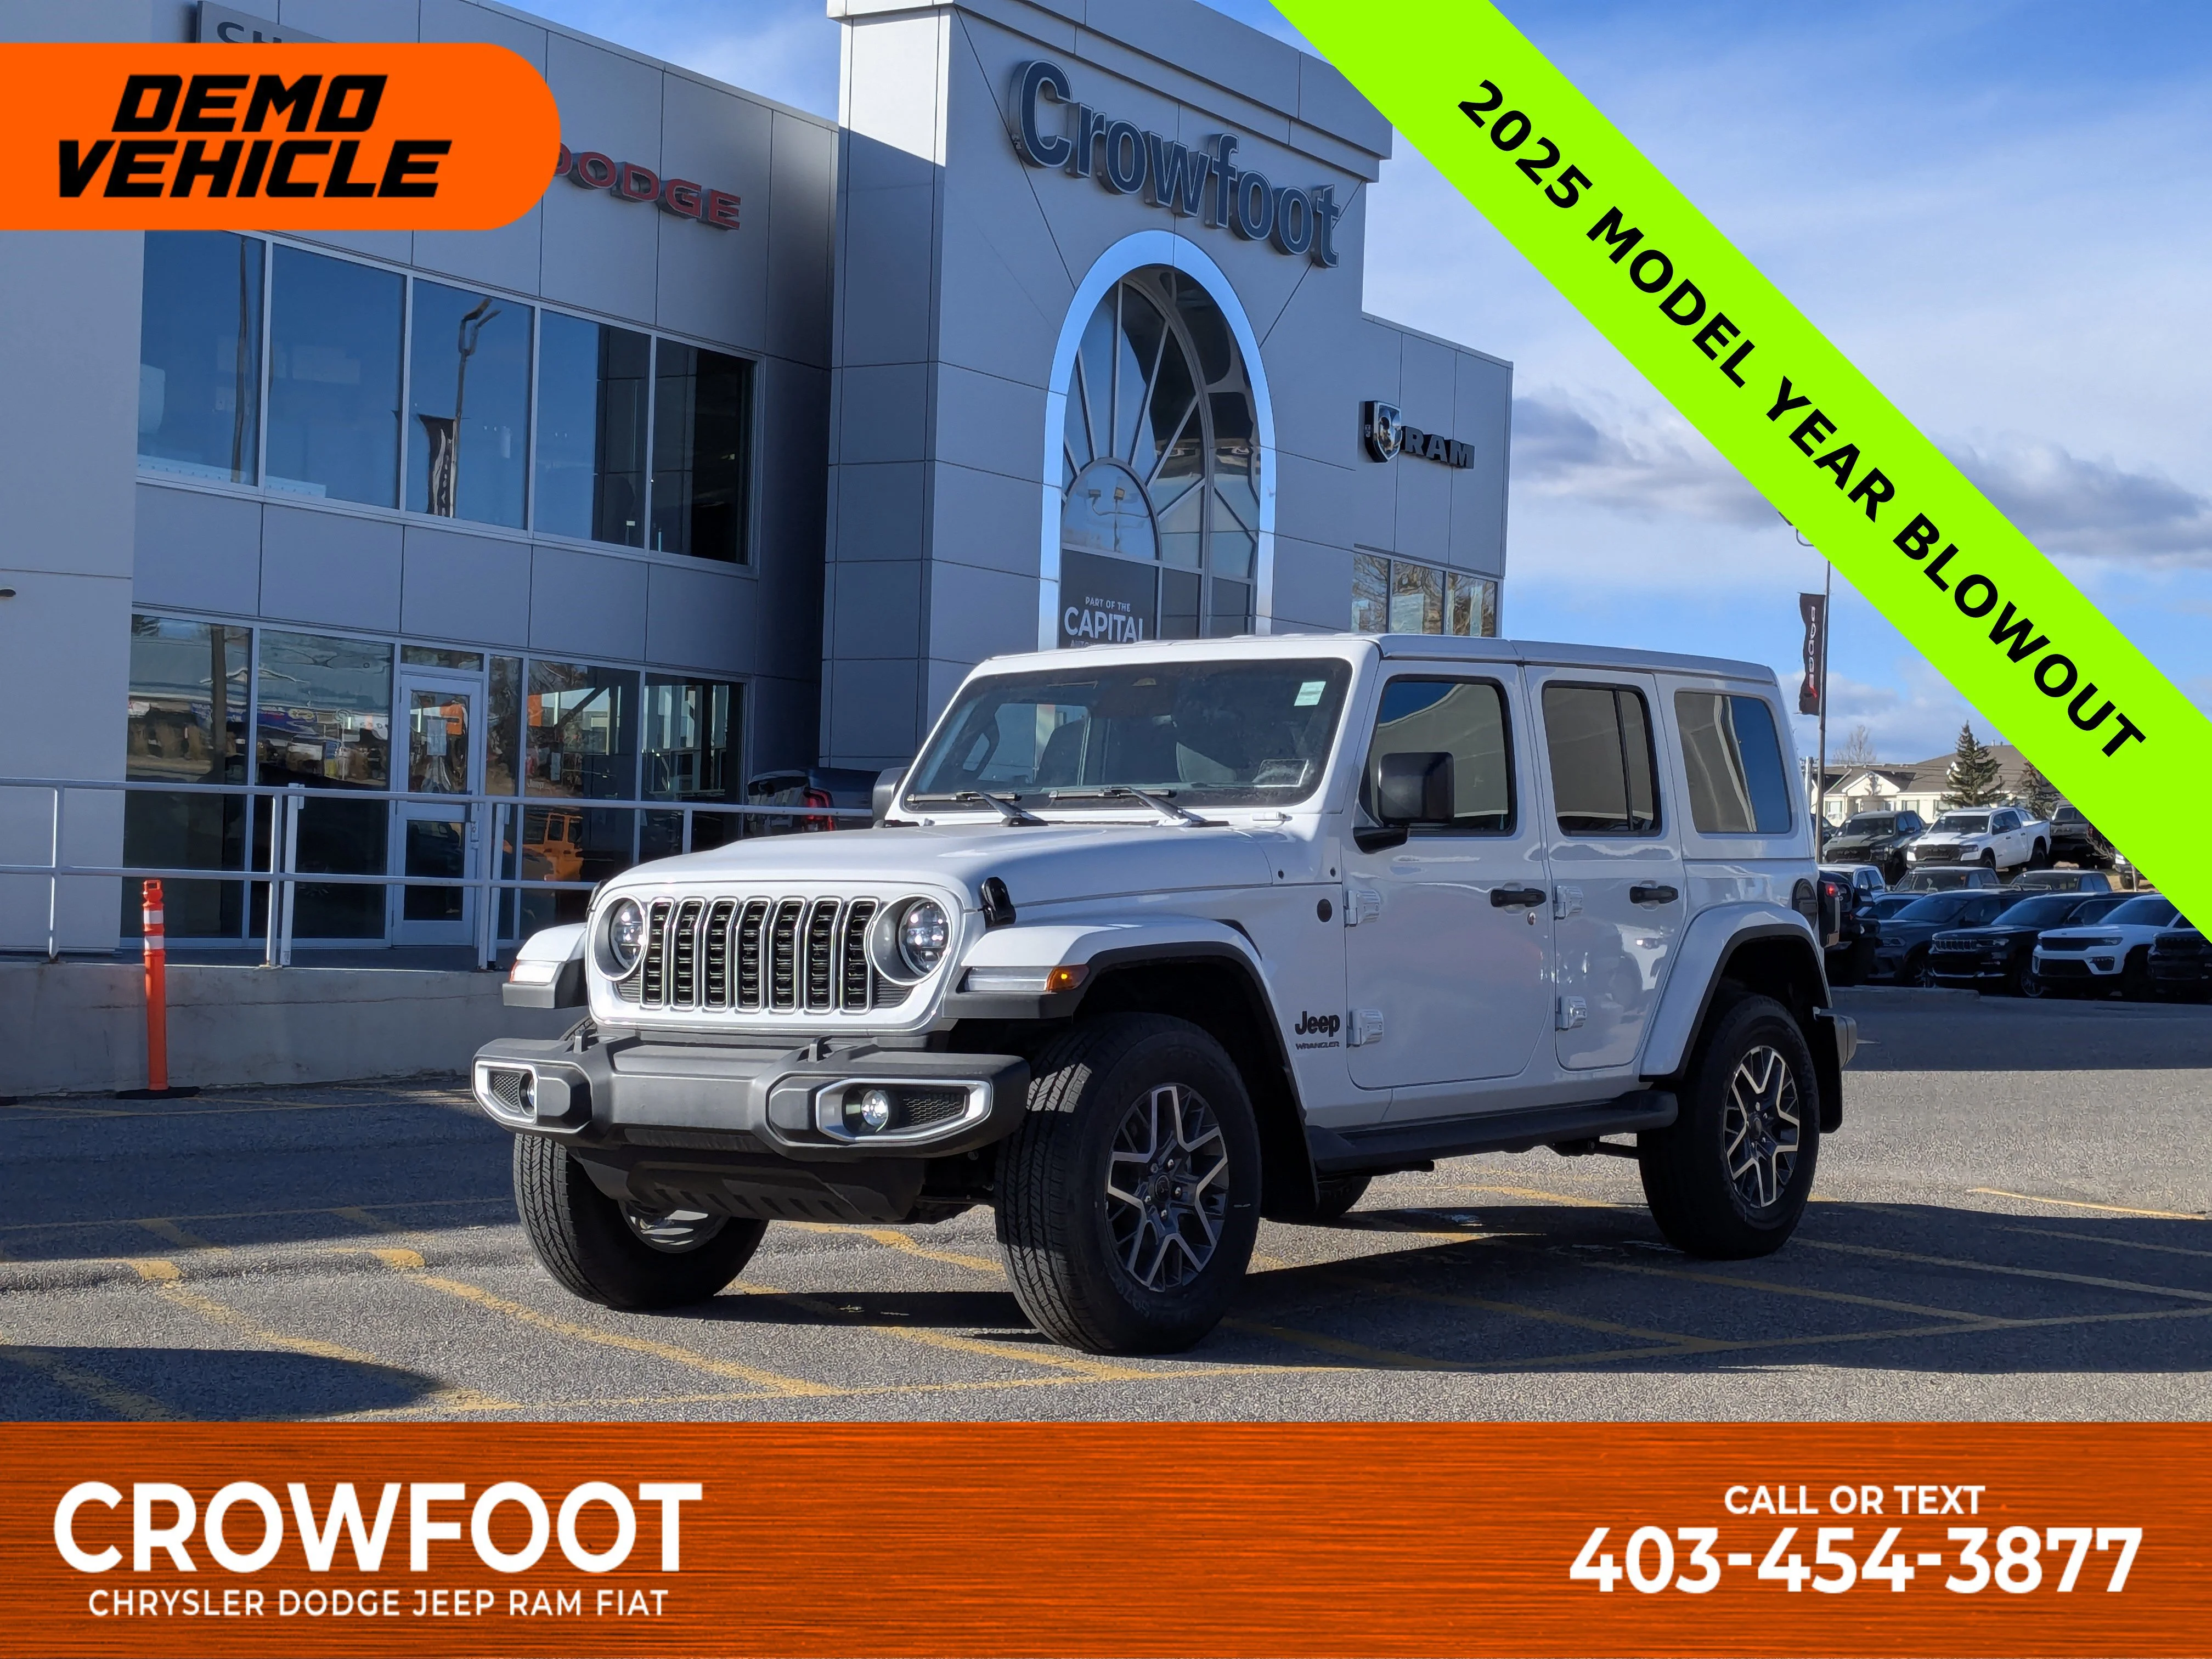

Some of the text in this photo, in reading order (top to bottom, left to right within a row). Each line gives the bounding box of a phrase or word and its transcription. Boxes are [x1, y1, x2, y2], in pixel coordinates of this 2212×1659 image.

[1012, 59, 1340, 268] Crowfoot
[1403, 426, 1475, 469] RAM
[1085, 596, 1131, 612] PART OF THE
[1295, 1011, 1340, 1037] Jeep
